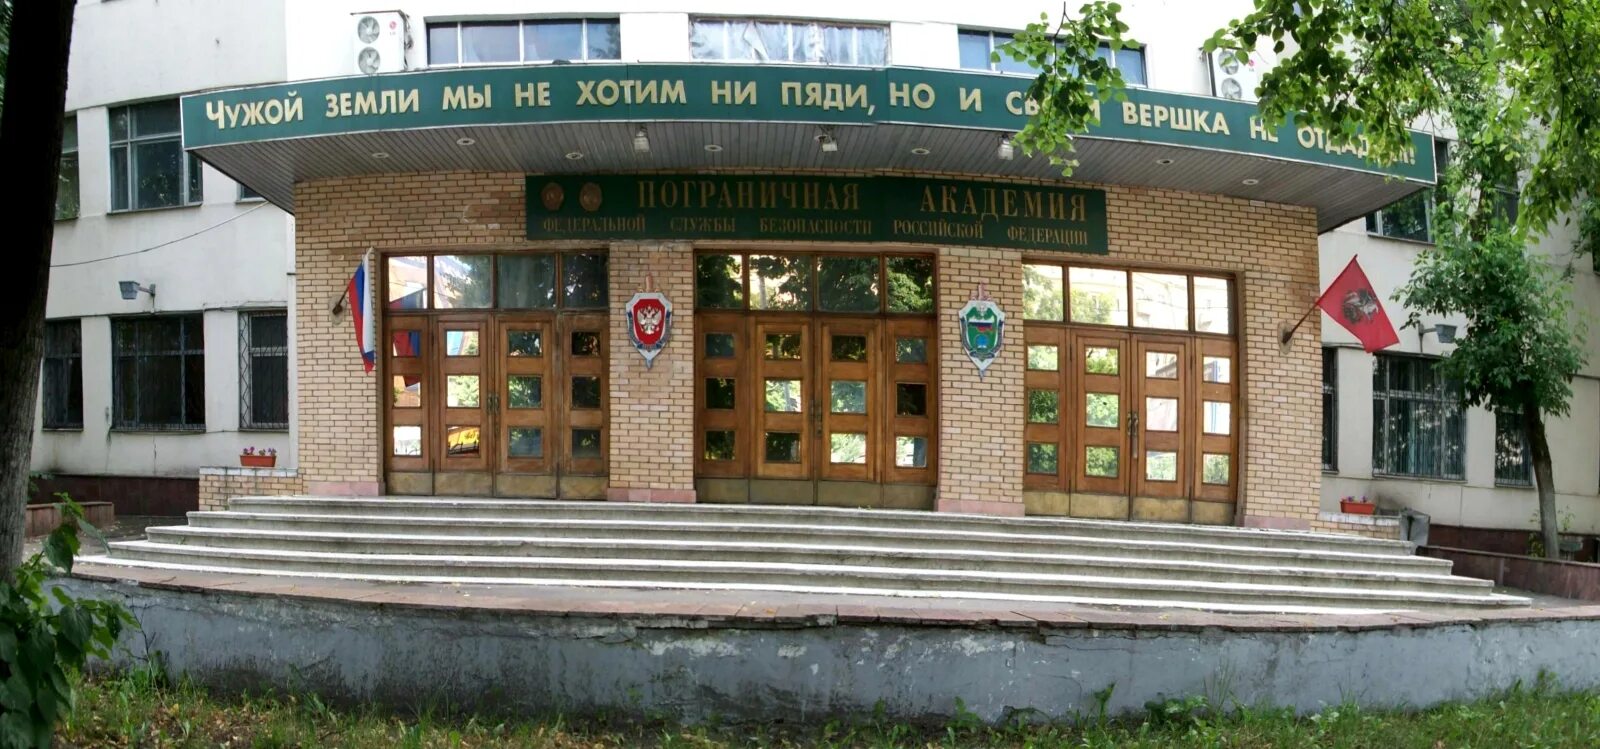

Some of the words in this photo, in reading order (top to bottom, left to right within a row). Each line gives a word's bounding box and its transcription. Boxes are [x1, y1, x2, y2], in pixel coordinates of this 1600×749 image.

[325, 88, 420, 118] ЗЕМЛИ
[441, 84, 492, 111] МЫ
[514, 82, 552, 107] НЕ
[576, 79, 687, 106] ХОТИМ
[711, 80, 757, 106] НИ
[781, 81, 875, 116] ПЯДИ,
[889, 81, 936, 110] НО
[960, 87, 982, 112] И
[1122, 101, 1231, 136] ВЕРШКА
[1297, 122, 1416, 166] ОТДАД!
[637, 180, 860, 210] ПОГРАНИЧНАЯ
[920, 184, 1087, 222] АКАДЕМИЯ
[543, 215, 646, 235] ФЕДЕРАЛЬНОЙ
[669, 216, 736, 233] СЛУЖБЫ
[759, 217, 872, 235] БЕЗОПАСНОСТИ
[893, 217, 984, 240] РОССИЙСКОЙ
[1007, 224, 1088, 247] ФЕДЕРАЦИИ
